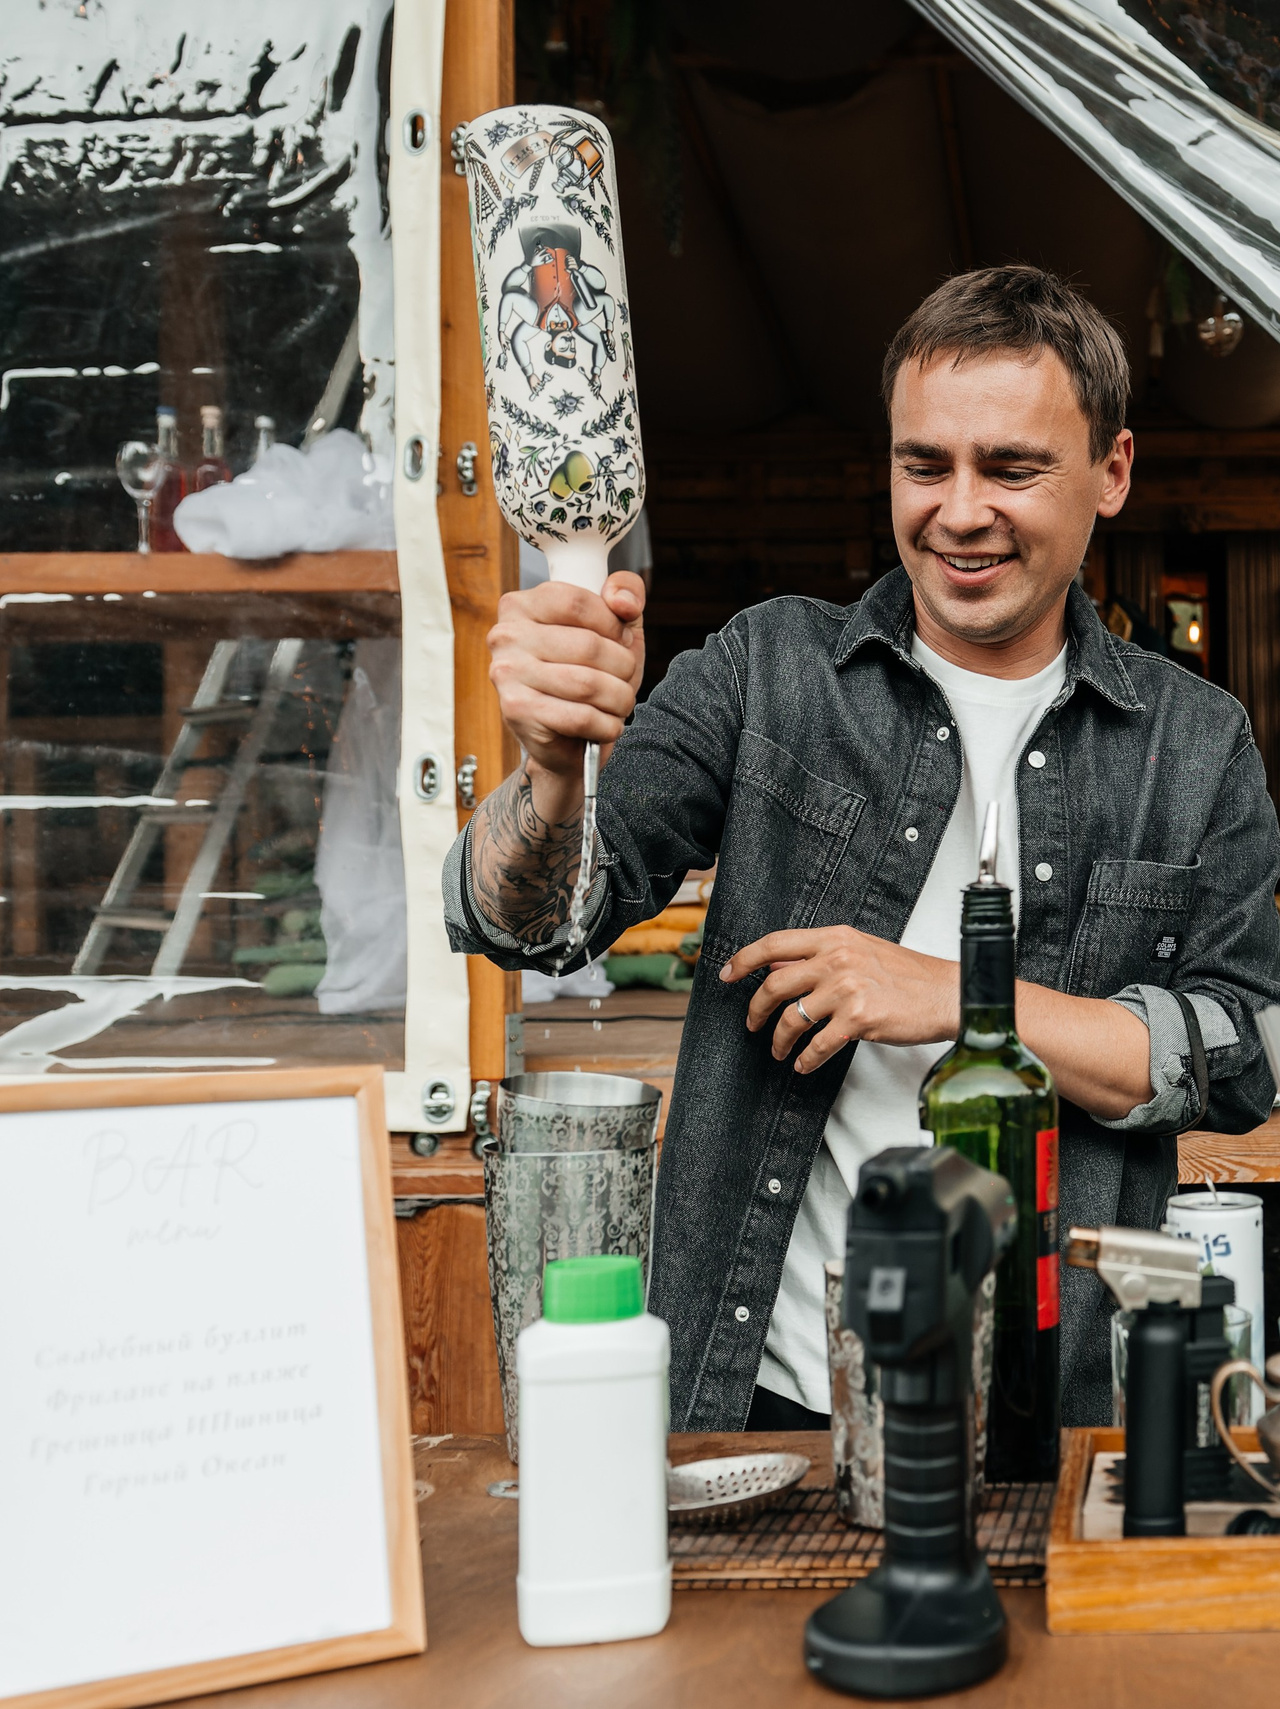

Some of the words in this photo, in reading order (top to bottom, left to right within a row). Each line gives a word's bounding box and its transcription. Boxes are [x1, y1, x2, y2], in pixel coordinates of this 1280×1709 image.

[507, 138, 550, 170] VESPER
[82, 1118, 264, 1216] BAR
[127, 1217, 222, 1249] menu
[34, 1330, 192, 1370] Свадебный
[204, 1323, 306, 1355] буллит
[46, 1378, 170, 1416] Фриланс
[182, 1375, 215, 1394] на
[227, 1363, 311, 1389] пляже
[29, 1422, 174, 1466] Грешница
[83, 1460, 188, 1498] Горный
[201, 1452, 287, 1479] Океан
